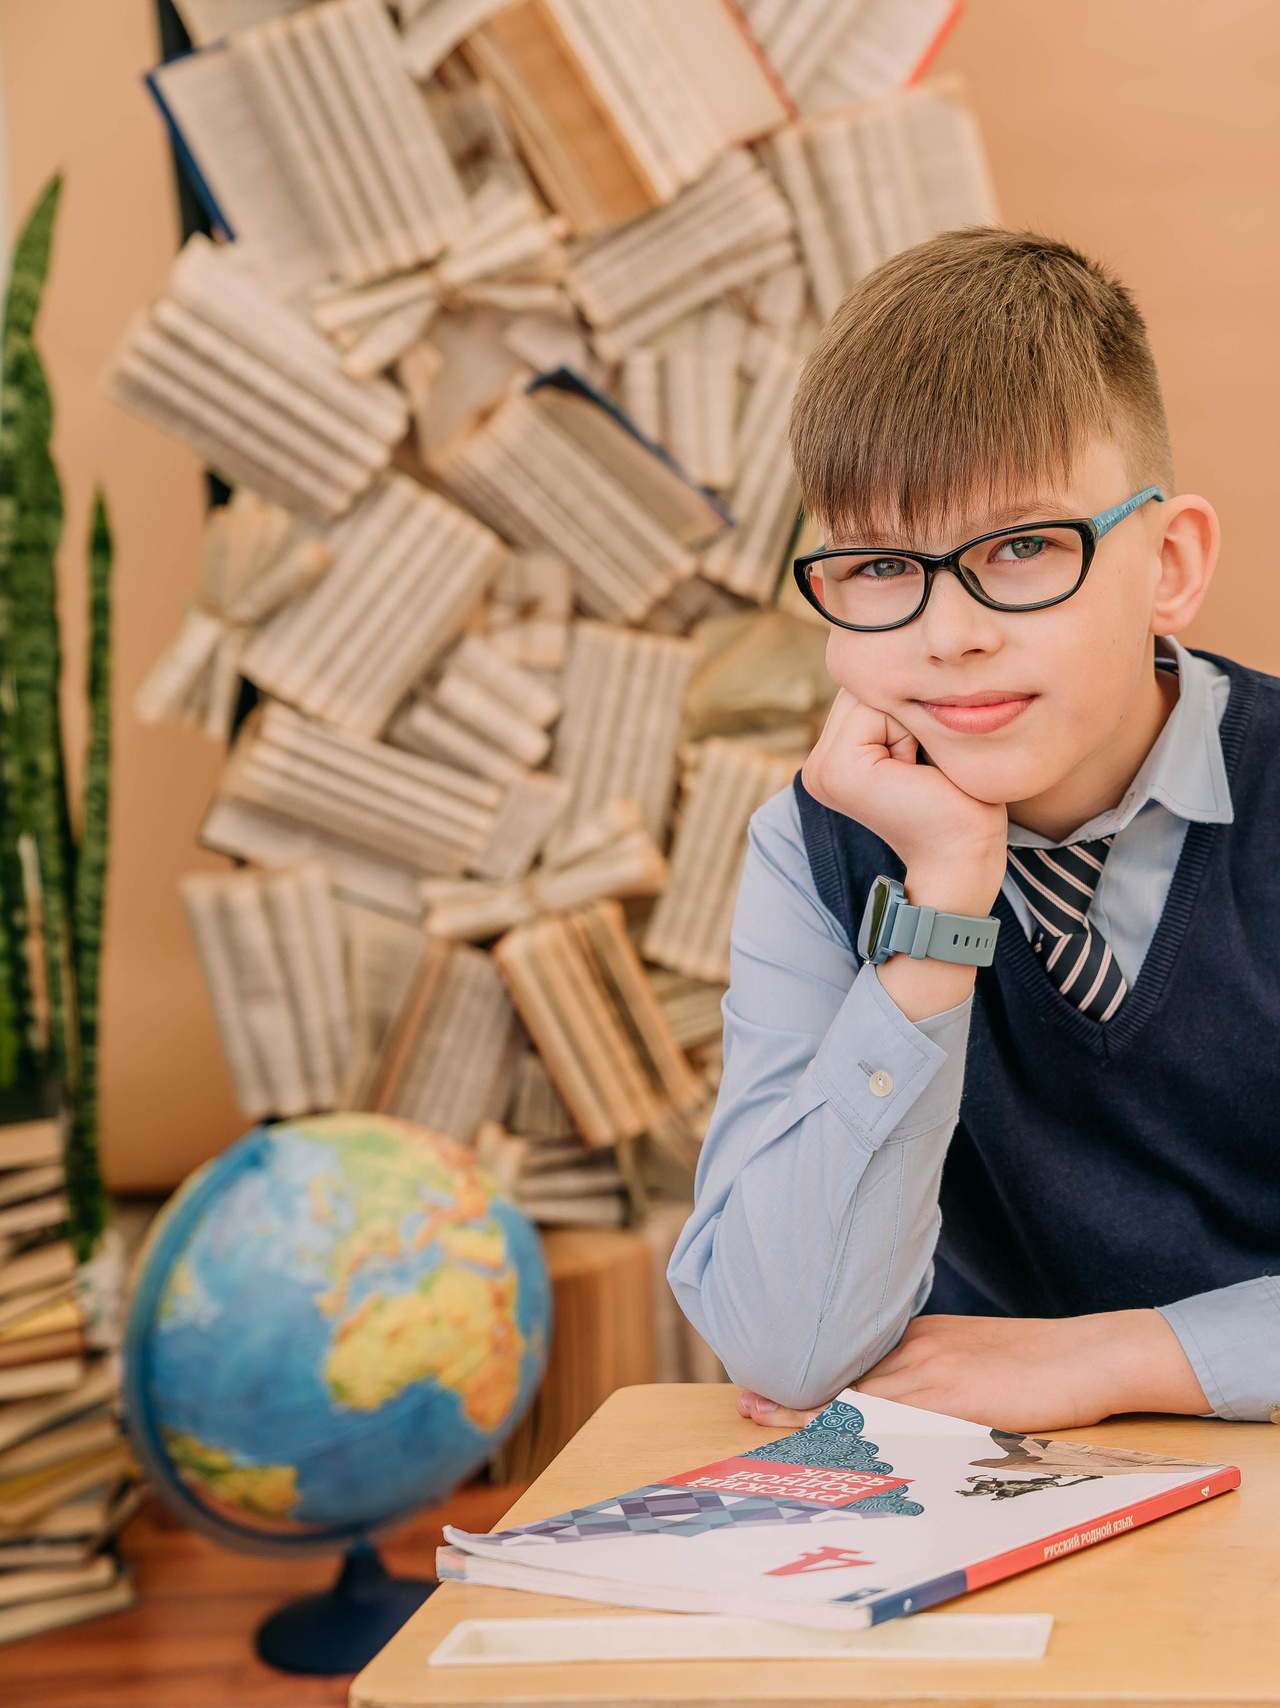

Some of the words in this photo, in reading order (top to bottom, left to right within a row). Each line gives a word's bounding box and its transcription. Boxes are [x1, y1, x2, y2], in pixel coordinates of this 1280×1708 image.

[686, 1476, 850, 1503] РУССКИЙ
[724, 1470, 872, 1495] РОДНОЙ
[793, 1468, 893, 1487] ЯЗЫК
[1201, 1485, 1210, 1498] 4
[1043, 1533, 1080, 1560] РУССКИЙ
[1080, 1520, 1112, 1546] РОДНОЙ
[1112, 1515, 1134, 1533] ЯЗЫК
[762, 1545, 877, 1577] 4
